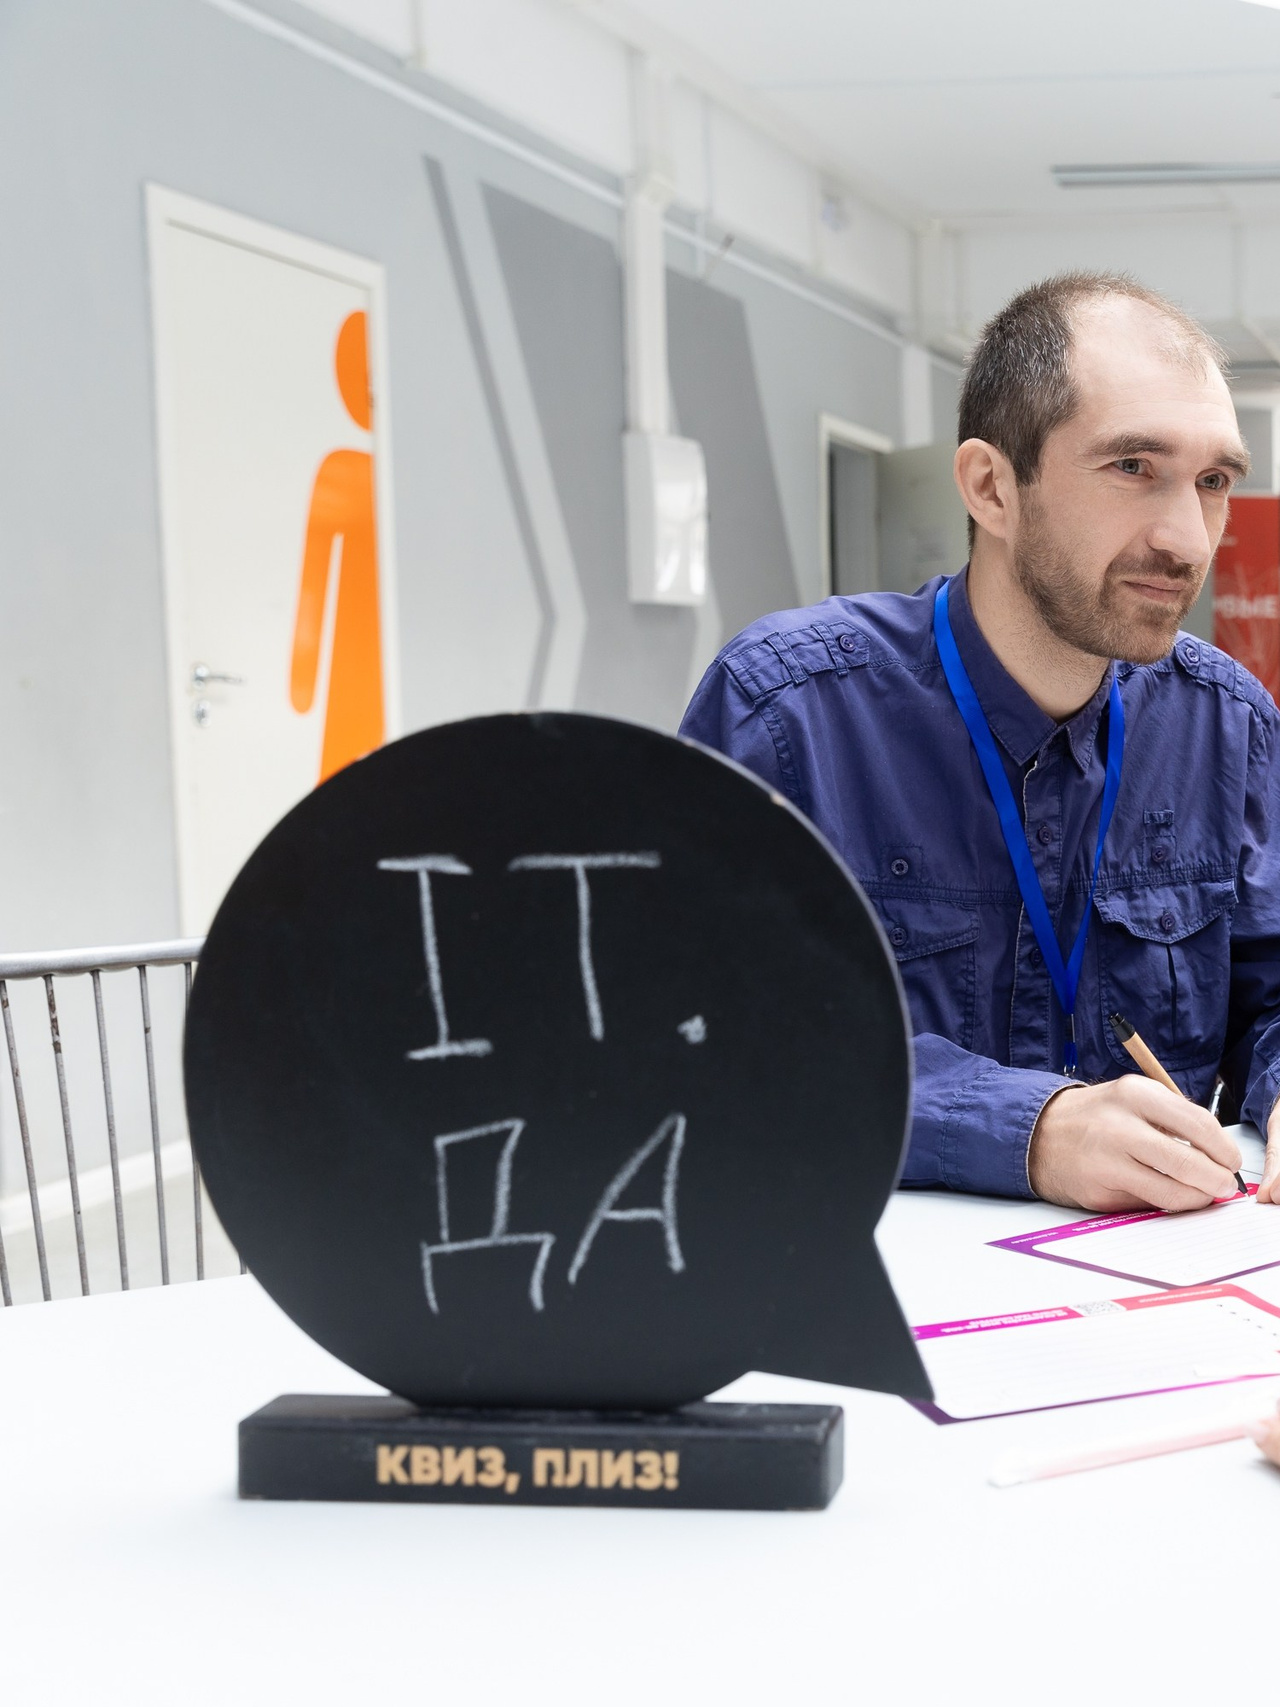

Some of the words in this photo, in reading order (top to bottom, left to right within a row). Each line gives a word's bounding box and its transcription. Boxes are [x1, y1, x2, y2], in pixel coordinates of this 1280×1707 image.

[420, 1112, 686, 1314] ДА
[376, 1445, 522, 1494] КВИЗ,
[532, 1448, 679, 1491] ПЛИЗ!
